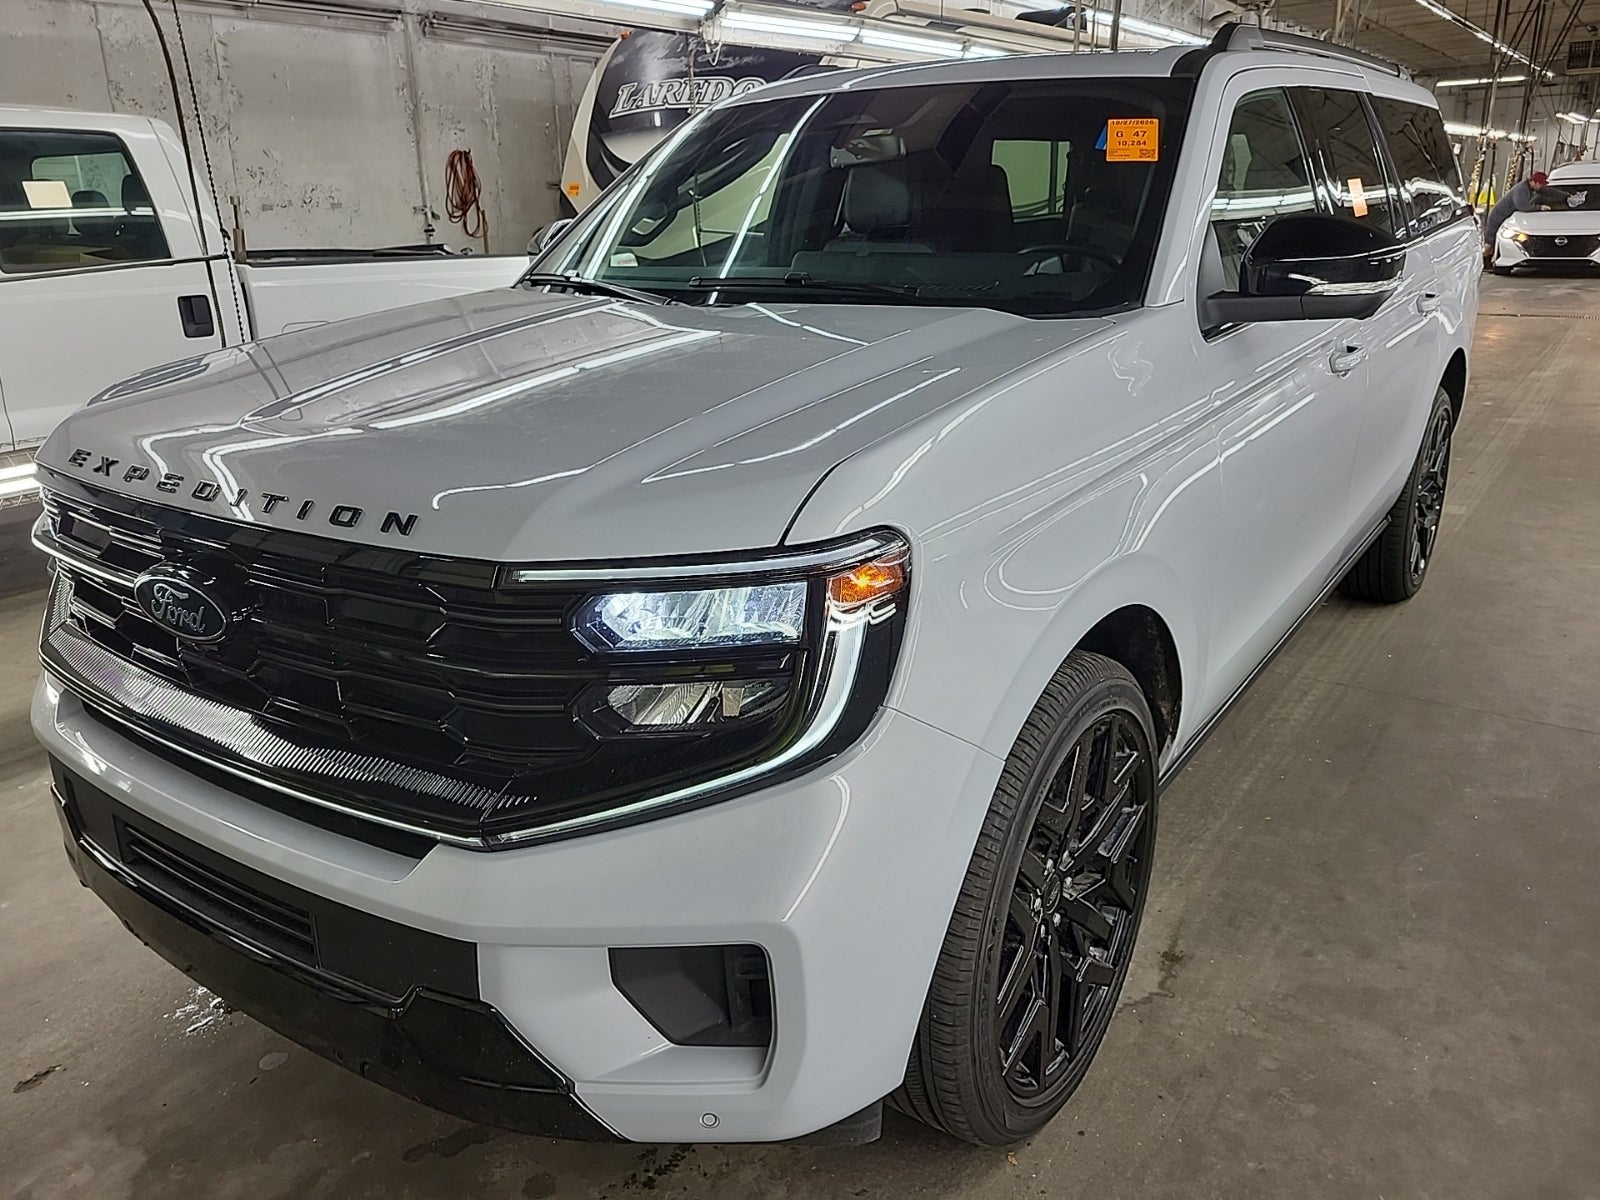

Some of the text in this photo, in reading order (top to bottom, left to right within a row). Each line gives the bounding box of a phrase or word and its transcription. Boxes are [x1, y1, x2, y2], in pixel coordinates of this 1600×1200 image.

[1115, 130, 1147, 138] G 47
[67, 447, 420, 538] EXPEDITION
[150, 581, 208, 634] Ford
